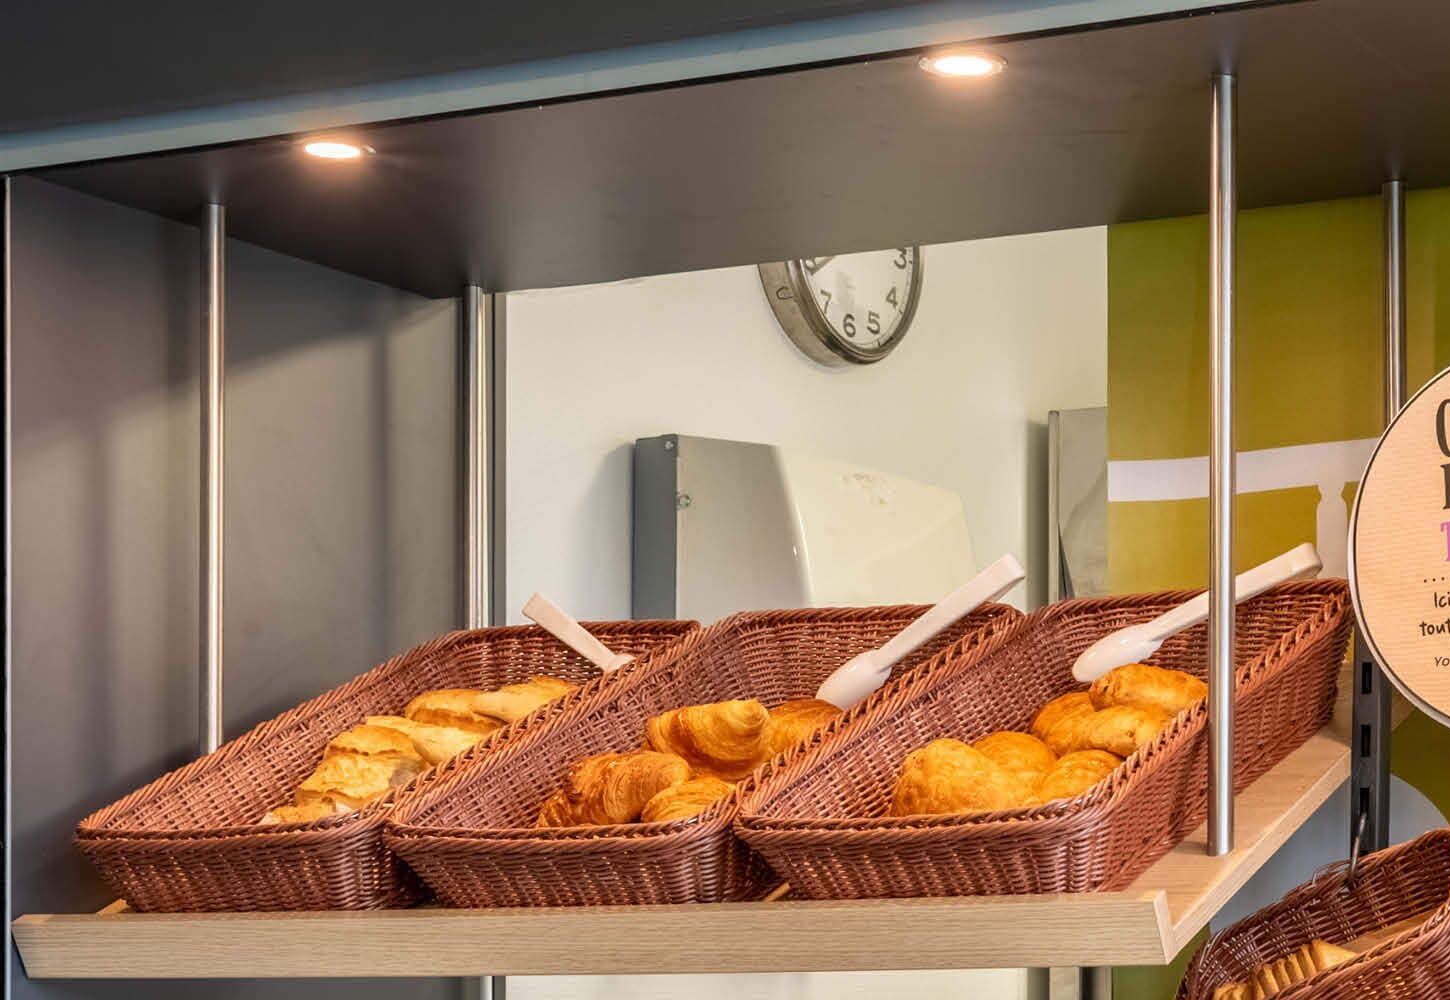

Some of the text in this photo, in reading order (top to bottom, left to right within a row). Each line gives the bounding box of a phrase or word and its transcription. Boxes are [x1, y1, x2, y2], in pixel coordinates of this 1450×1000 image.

[820, 289, 832, 314] 7
[885, 286, 899, 308] 4
[842, 313, 856, 338] 6
[867, 310, 881, 335] 5
